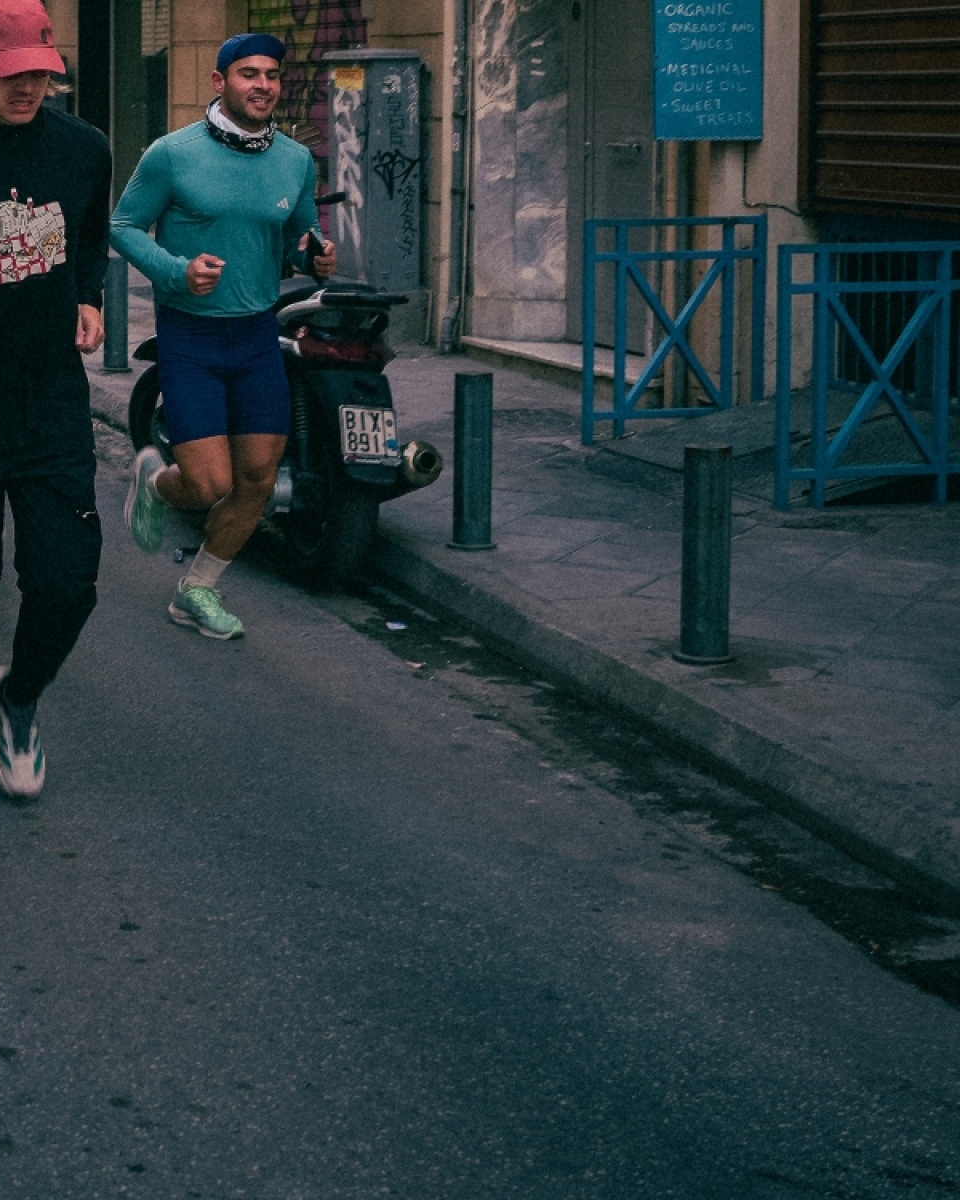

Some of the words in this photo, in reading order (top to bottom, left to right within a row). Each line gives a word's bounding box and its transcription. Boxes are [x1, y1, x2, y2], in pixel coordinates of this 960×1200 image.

[664, 2, 734, 17] ORGANIC
[668, 22, 728, 34] SPREADS
[731, 23, 756, 34] AND
[680, 38, 734, 52] SAUCES
[666, 63, 753, 77] MEDICINAL
[673, 80, 714, 93] OLIVE
[719, 81, 747, 92] OIL
[696, 112, 754, 127] TREATS
[345, 410, 382, 433] BIX
[348, 430, 380, 454] 891
